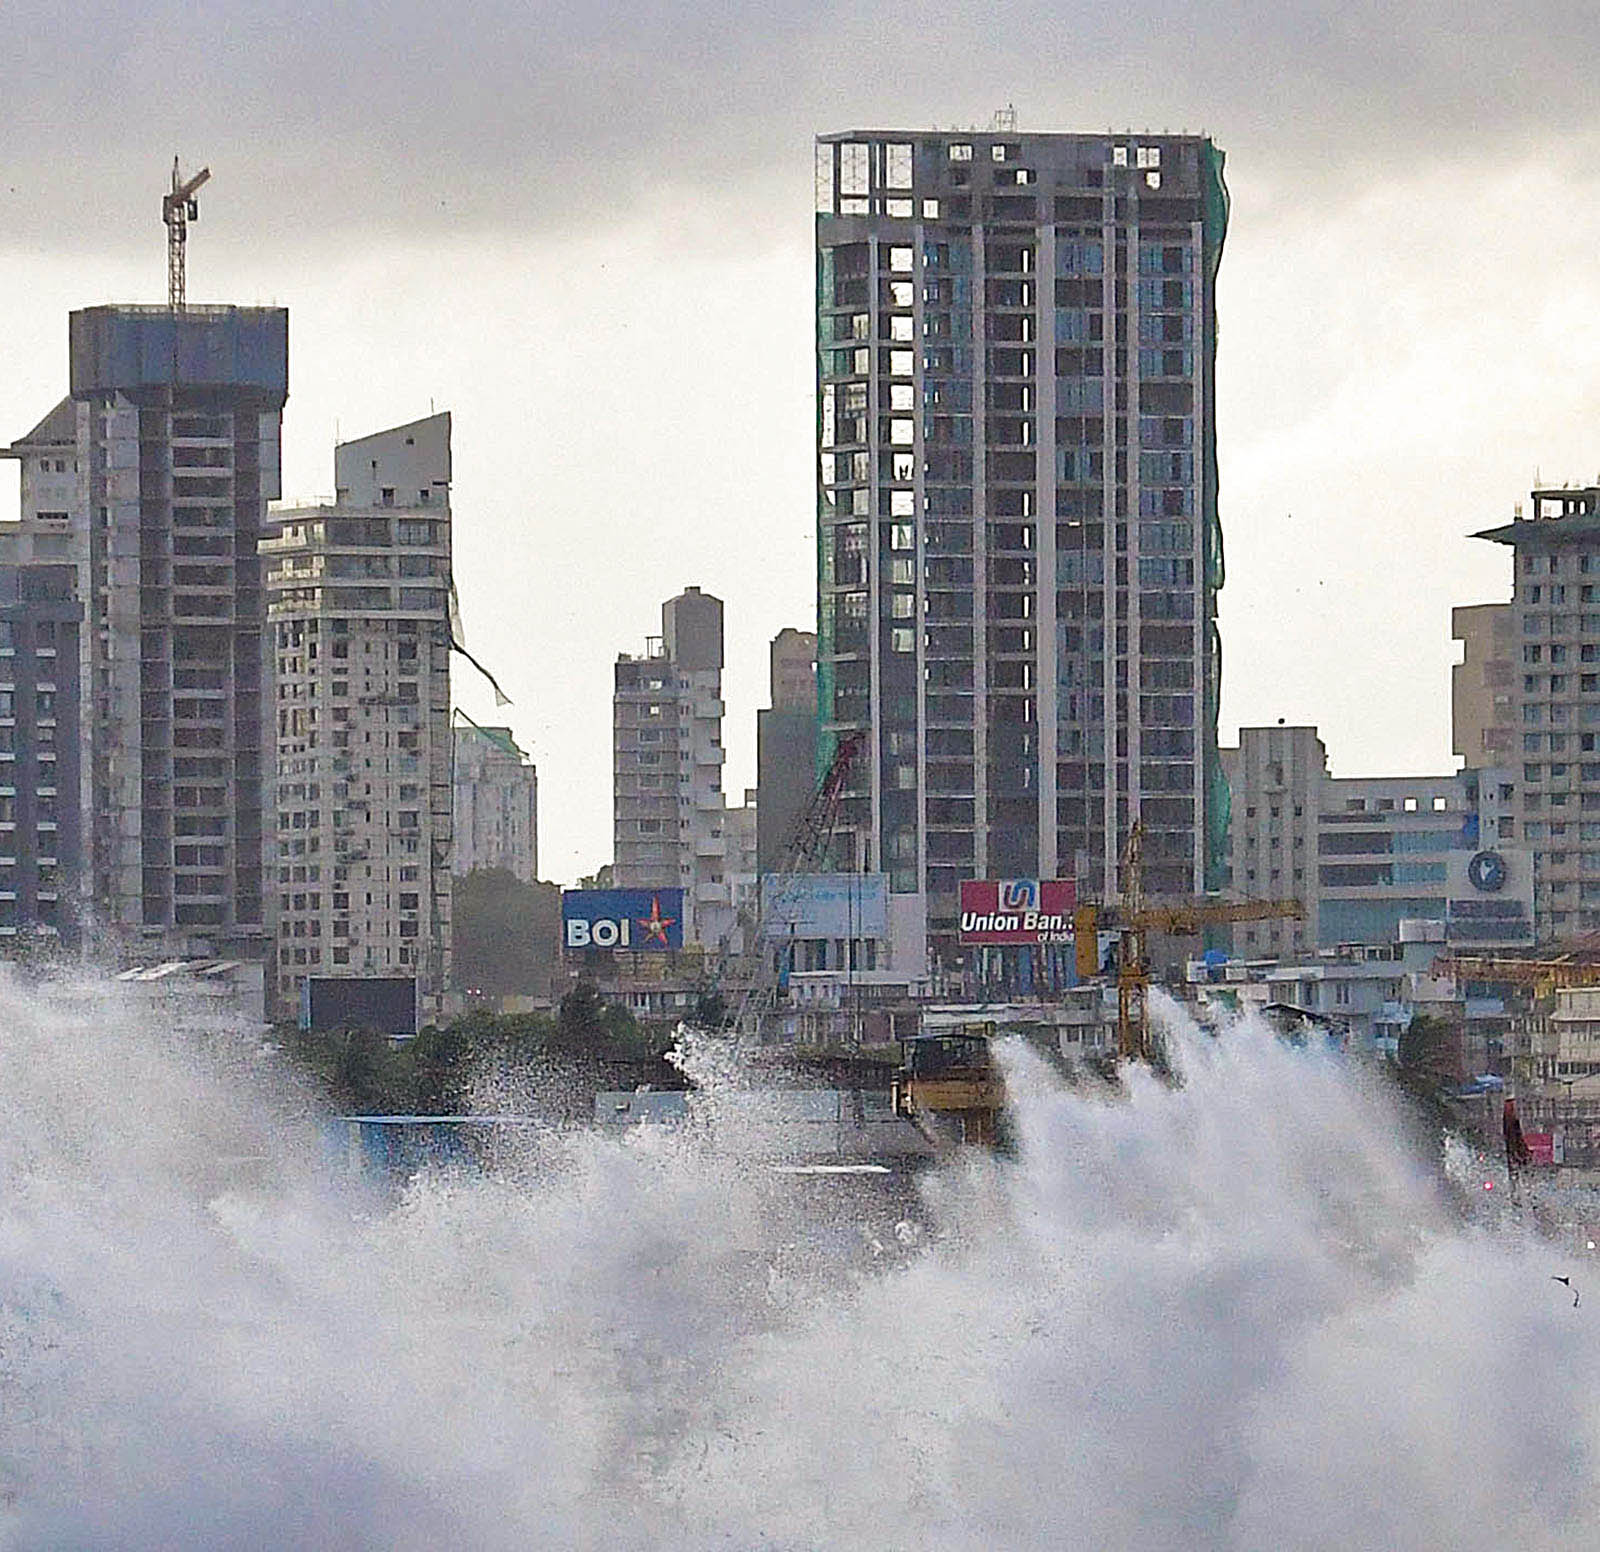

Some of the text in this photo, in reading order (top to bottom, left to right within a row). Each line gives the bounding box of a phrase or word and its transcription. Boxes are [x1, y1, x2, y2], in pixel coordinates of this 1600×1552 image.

[961, 912, 1019, 931] Union
[567, 918, 630, 947] BOI
[1037, 931, 1075, 942] of India
